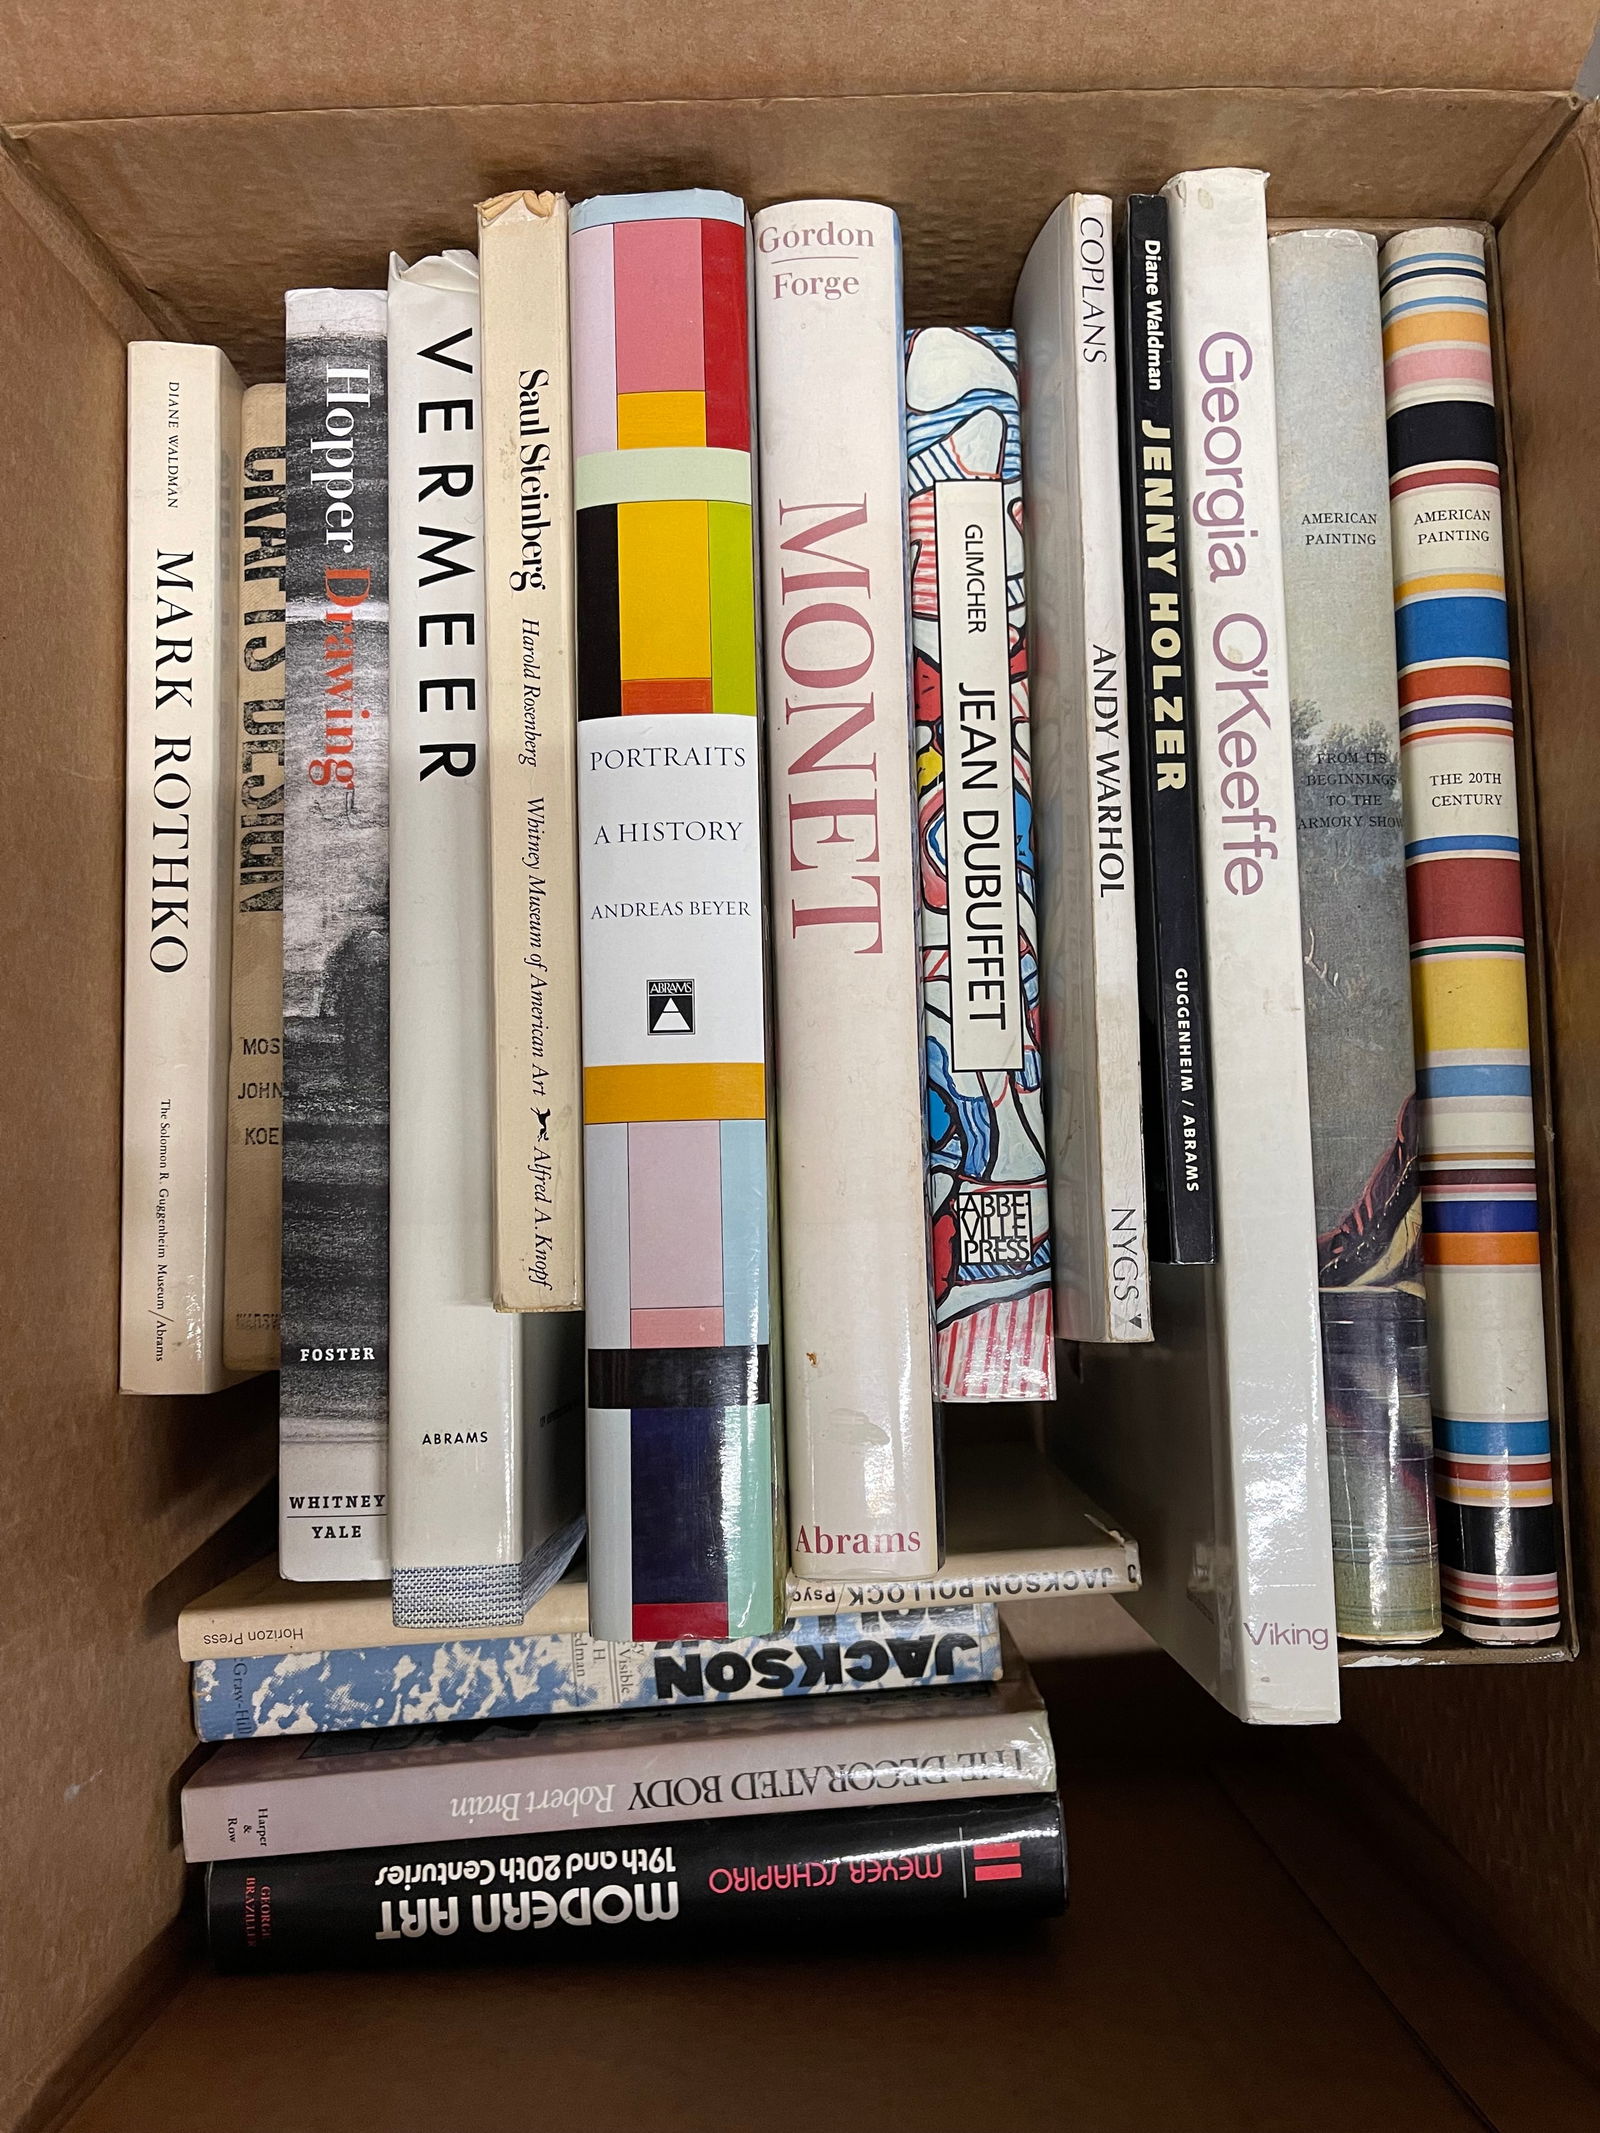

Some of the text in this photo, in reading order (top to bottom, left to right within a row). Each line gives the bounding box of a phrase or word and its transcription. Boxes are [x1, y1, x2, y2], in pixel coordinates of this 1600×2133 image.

[757, 219, 876, 255] Gordon
[772, 271, 860, 301] Forge
[1079, 216, 1107, 364] COPLANS
[1144, 239, 1163, 391] Diane Waldman
[168, 381, 180, 509] DIANE WALDMAN
[1192, 331, 1259, 584] Georgia
[508, 367, 551, 592] Saul Steinberg
[1301, 512, 1378, 526] AMERICAN
[1413, 508, 1491, 526] AMERICAN
[1305, 533, 1377, 547] PAINTING
[1417, 530, 1490, 546] PAINTING
[416, 327, 477, 782] VERMEER
[308, 364, 372, 790] Hopper Drawing
[964, 523, 987, 635] GLIMCHER
[1141, 419, 1187, 791] JENNY HOLZER
[518, 617, 541, 768] Harold Rosenberg
[779, 492, 884, 954] MONET
[150, 548, 195, 974] MARK ROTHKO
[590, 746, 747, 772] PORTRAITS
[1092, 643, 1125, 899] ANDY WARHOL
[1316, 751, 1388, 766] FROM ITS
[1306, 773, 1397, 787] BEGINNINGS
[1429, 771, 1502, 787] THE 20TH
[1326, 794, 1384, 807] TO THE
[1431, 793, 1503, 808] CENTURY
[593, 821, 744, 845] A HISTORY
[1297, 815, 1363, 831] ARMORY
[958, 682, 1007, 1032] JEAN DUBUFFET
[590, 900, 752, 920] ANDREAS BEYER
[521, 797, 550, 1097] Whitney Museum of American Art
[649, 981, 693, 995] ABRAMS
[1174, 967, 1194, 1093] GUGGENHEIM
[243, 1038, 281, 1056] MOS
[161, 1098, 171, 1120] The
[159, 1122, 170, 1169] Solomon
[1182, 1113, 1200, 1193] ABRAMS
[160, 1171, 170, 1186] R.
[156, 1188, 170, 1259] Guggenheim
[527, 1145, 553, 1291] Alfred A. Knopf
[961, 1215, 1030, 1241] VILLE
[963, 1239, 1031, 1264] PRESS
[1110, 1207, 1140, 1302] NYGS
[300, 1347, 376, 1362] FOSTER
[421, 1431, 489, 1446] ABRAMS
[289, 1494, 386, 1510] WHITNEY
[311, 1525, 362, 1539] YALE
[794, 1524, 922, 1556] Abrams
[848, 1578, 975, 1608] POLLOCK
[984, 1566, 1113, 1598] JACKSON
[203, 1627, 304, 1647] Horizon Press
[1243, 1621, 1329, 1651] Viking
[618, 1648, 634, 1694] Visible
[654, 1633, 978, 1700] JACKSON
[627, 1746, 1022, 1811] THE DECORATED BODY
[450, 1783, 617, 1824] Robert Brain
[227, 1817, 238, 1843] Row
[243, 1824, 252, 1834] &
[256, 1807, 268, 1847] Harper
[374, 1845, 677, 1892] 19th and 20th Centuries
[708, 1852, 944, 1894] MEYER SCHAPIRO
[375, 1880, 680, 1941] MODERN ART
